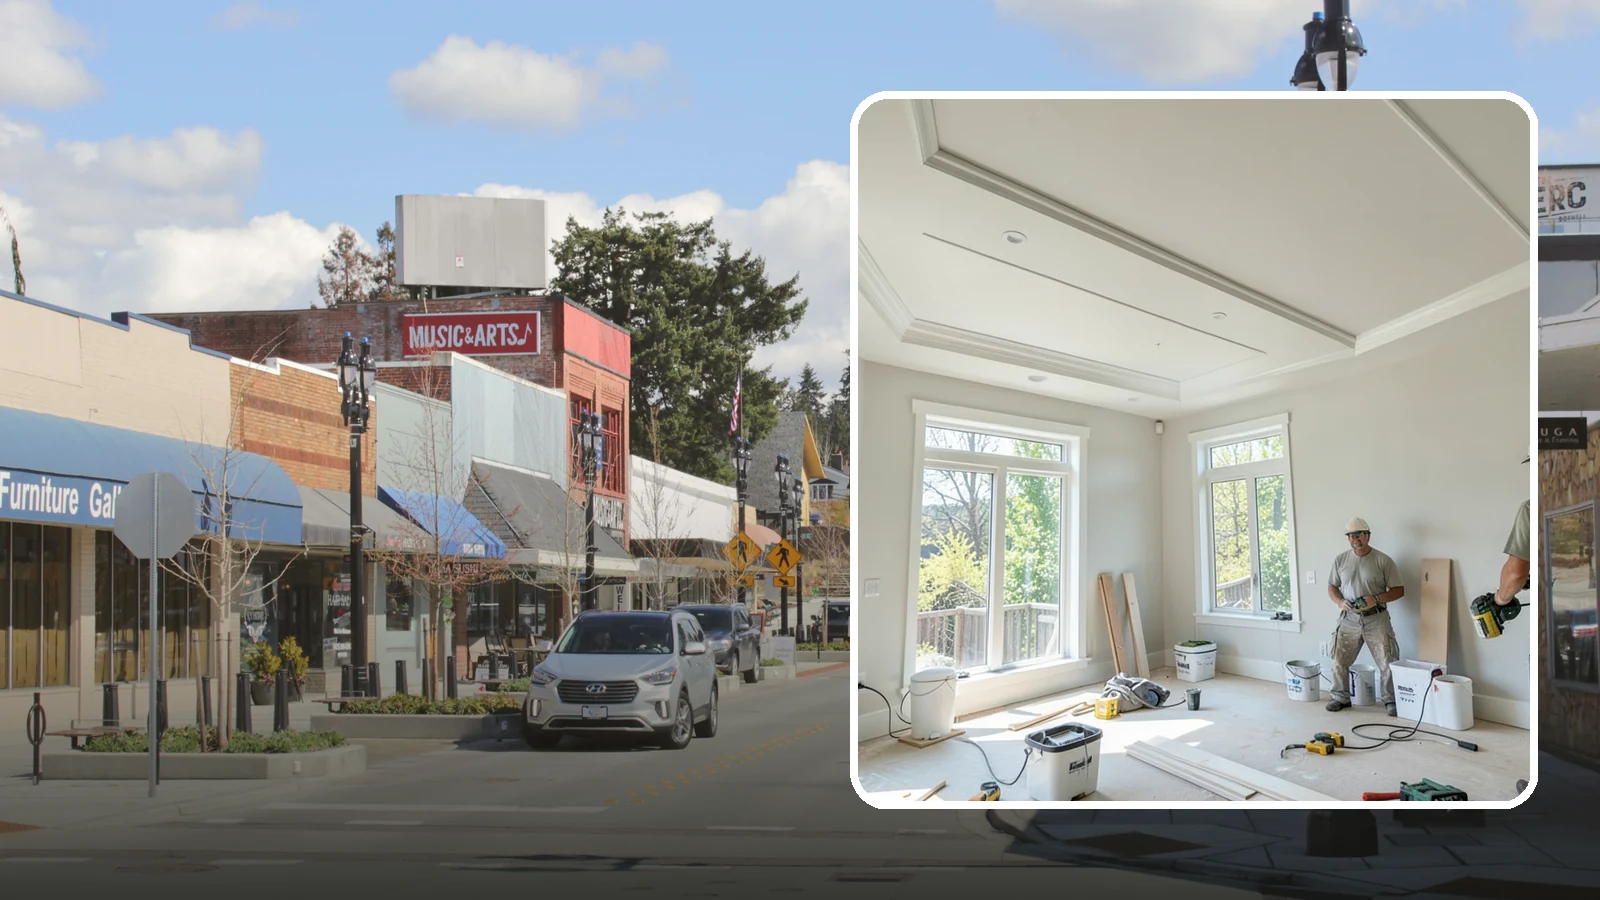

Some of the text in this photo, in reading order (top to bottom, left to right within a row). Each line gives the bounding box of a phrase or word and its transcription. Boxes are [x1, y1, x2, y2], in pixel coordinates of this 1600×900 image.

[408, 322, 520, 349] MUSIC&ARTS
[1540, 427, 1577, 437] UGA
[0, 471, 122, 519] Furniture Gal
